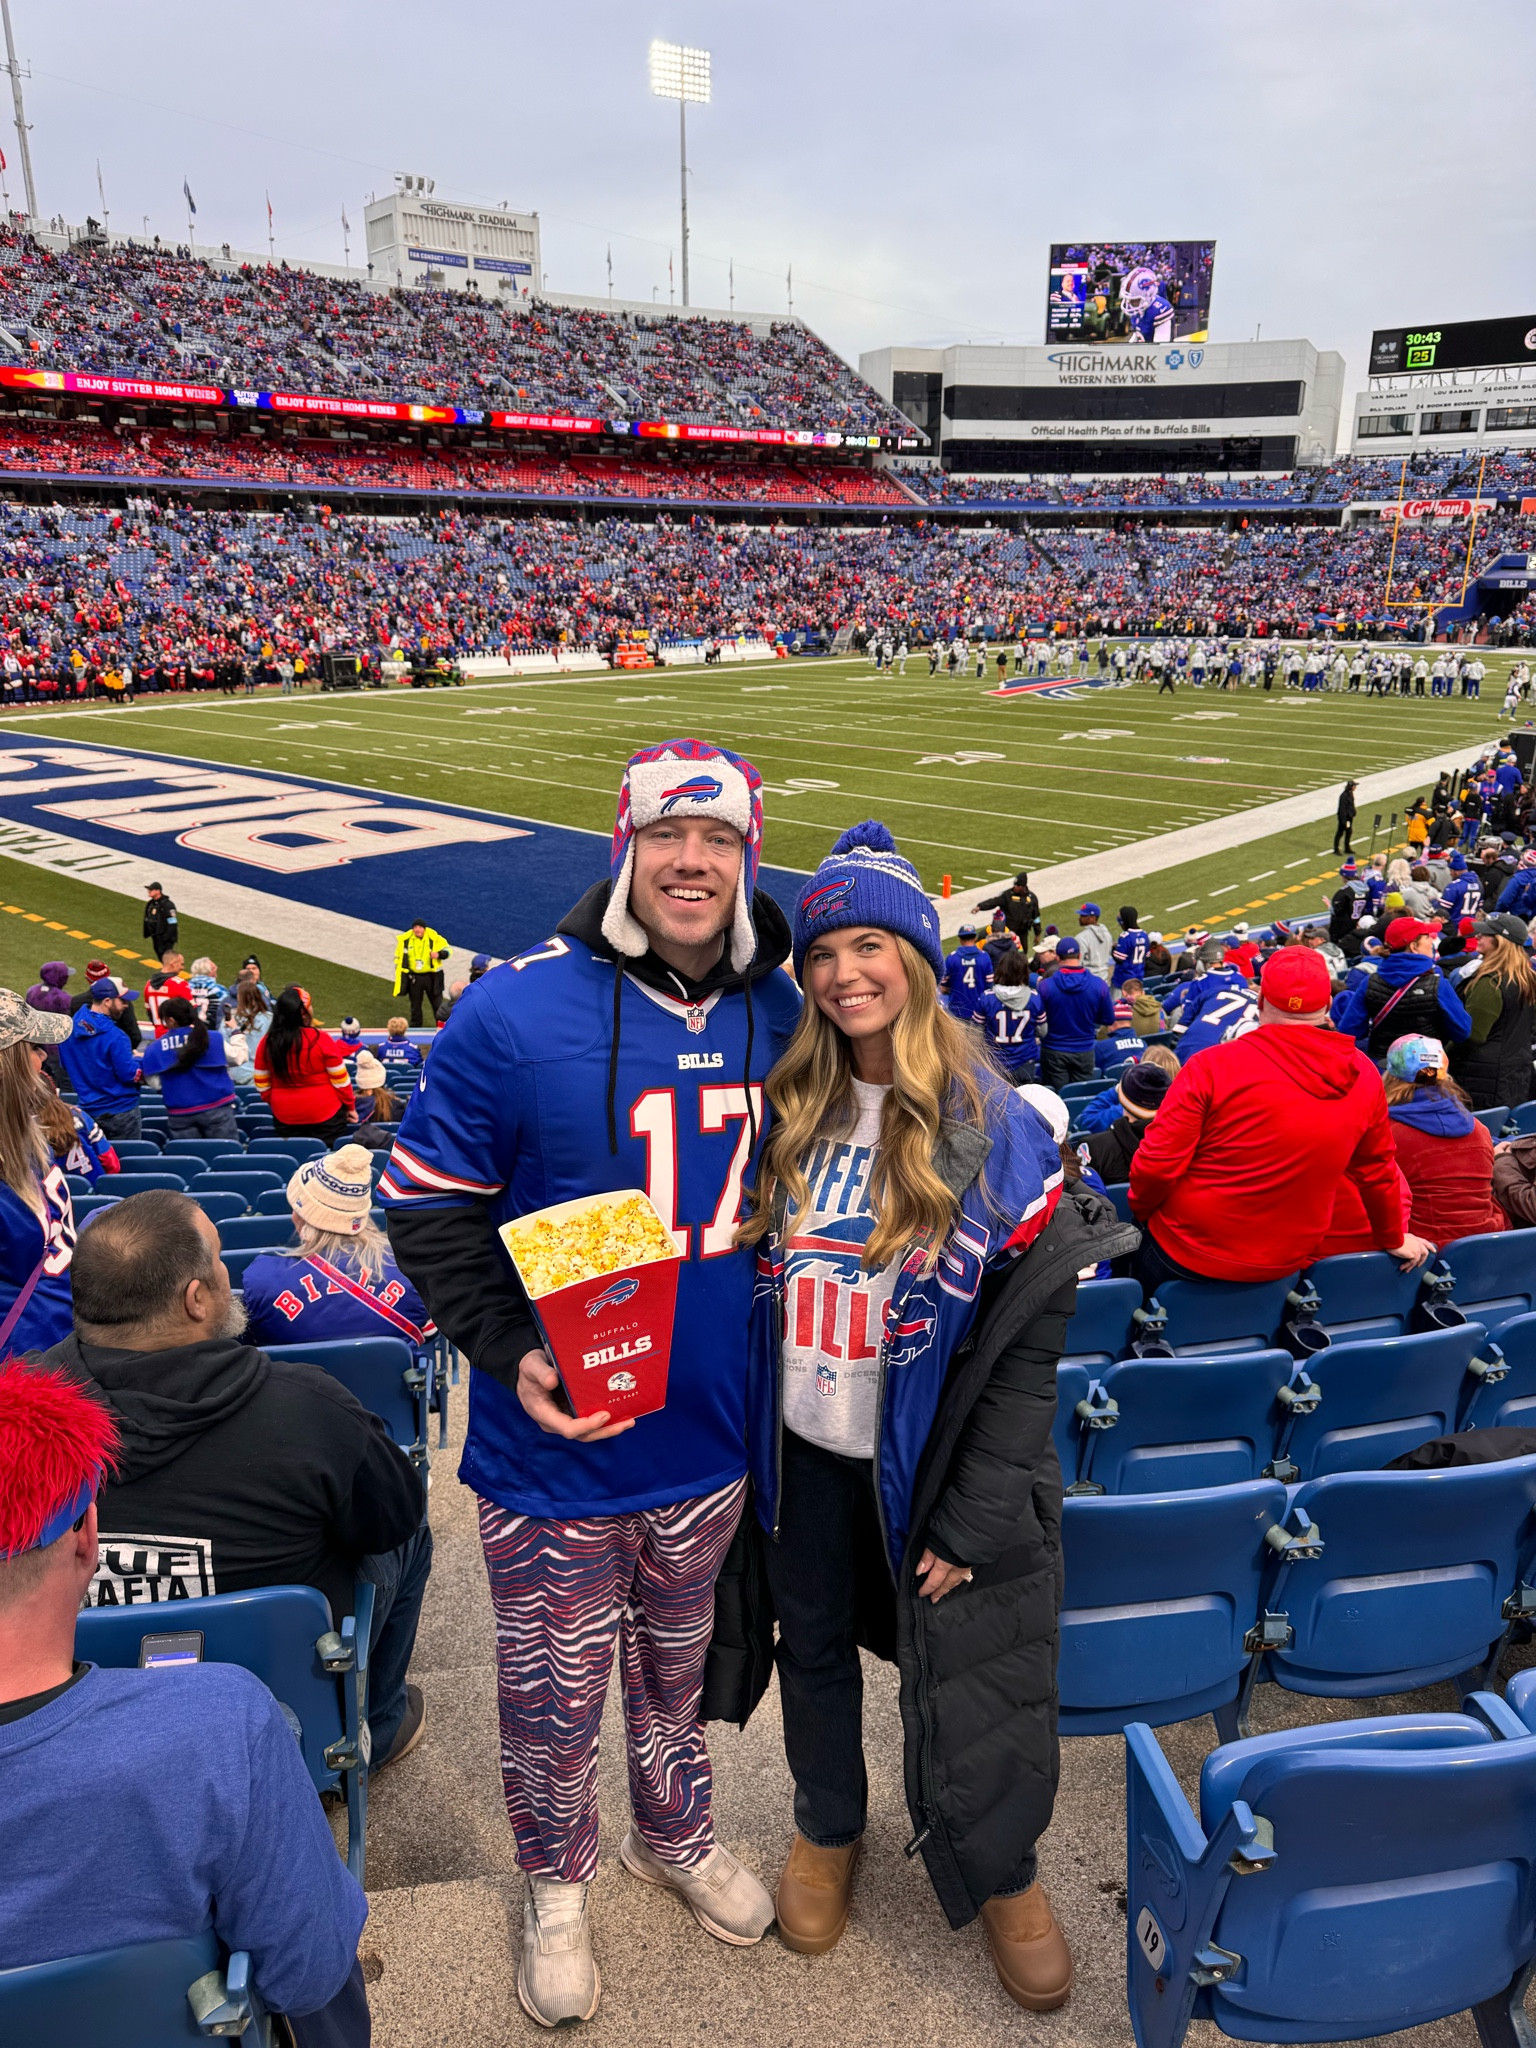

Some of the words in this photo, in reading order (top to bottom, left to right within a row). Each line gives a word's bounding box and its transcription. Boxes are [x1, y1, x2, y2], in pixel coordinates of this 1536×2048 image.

[421, 204, 475, 222] HIGHMARK
[479, 214, 518, 228] STADIUM
[421, 252, 444, 262] CONDUCT
[1405, 331, 1442, 346] 30:43
[1052, 352, 1157, 372] HIGHMARK
[1412, 350, 1430, 362] 25
[1059, 374, 1100, 385] WESTERN
[1104, 374, 1128, 384] NEW
[1129, 374, 1157, 384] YORK
[76, 377, 110, 391] ENJOY
[112, 381, 152, 394] SUTTER
[154, 385, 183, 397] HOME
[184, 388, 217, 400] WINES
[233, 389, 260, 399] SUTTER
[275, 396, 305, 407] ENJOY
[306, 399, 342, 411] SUTTER
[342, 402, 367, 413] HOME
[368, 404, 397, 416] WINES
[505, 414, 528, 425] RIGHT
[551, 417, 574, 428] RIGHT
[574, 419, 593, 430] NOW
[1031, 426, 1065, 436] Official
[1067, 426, 1098, 436] Health
[1100, 426, 1122, 435] Plan
[1123, 425, 1133, 434] of
[1134, 425, 1151, 434] the
[1153, 424, 1189, 435] Buffalo
[1190, 424, 1211, 434] Bills
[687, 427, 710, 437] ENJOY
[711, 428, 738, 439] SUTTER
[1408, 500, 1465, 517] Galbani
[1499, 579, 1528, 588] BILLS
[914, 750, 1007, 765] 20
[762, 778, 840, 796] 10
[48, 859, 134, 872] IT
[1460, 891, 1483, 916] 17
[1133, 945, 1146, 964] 17
[963, 966, 976, 988] 4
[689, 1017, 705, 1029] NFL
[995, 1010, 1031, 1044] 17
[1115, 1037, 1144, 1050] BILLS
[386, 1048, 405, 1058] ALLEN
[677, 1053, 724, 1070] BILLS
[65, 1145, 93, 1175] 4
[629, 1082, 764, 1261] 17
[784, 1276, 892, 1362] ILL
[593, 1321, 639, 1340] BUFFALO
[582, 1335, 652, 1370] BILLS
[779, 1357, 804, 1366] AST
[816, 1375, 834, 1394] NFL
[623, 1391, 639, 1400] EAST
[97, 1550, 191, 1576] UF
[1144, 1920, 1159, 1953] 19
